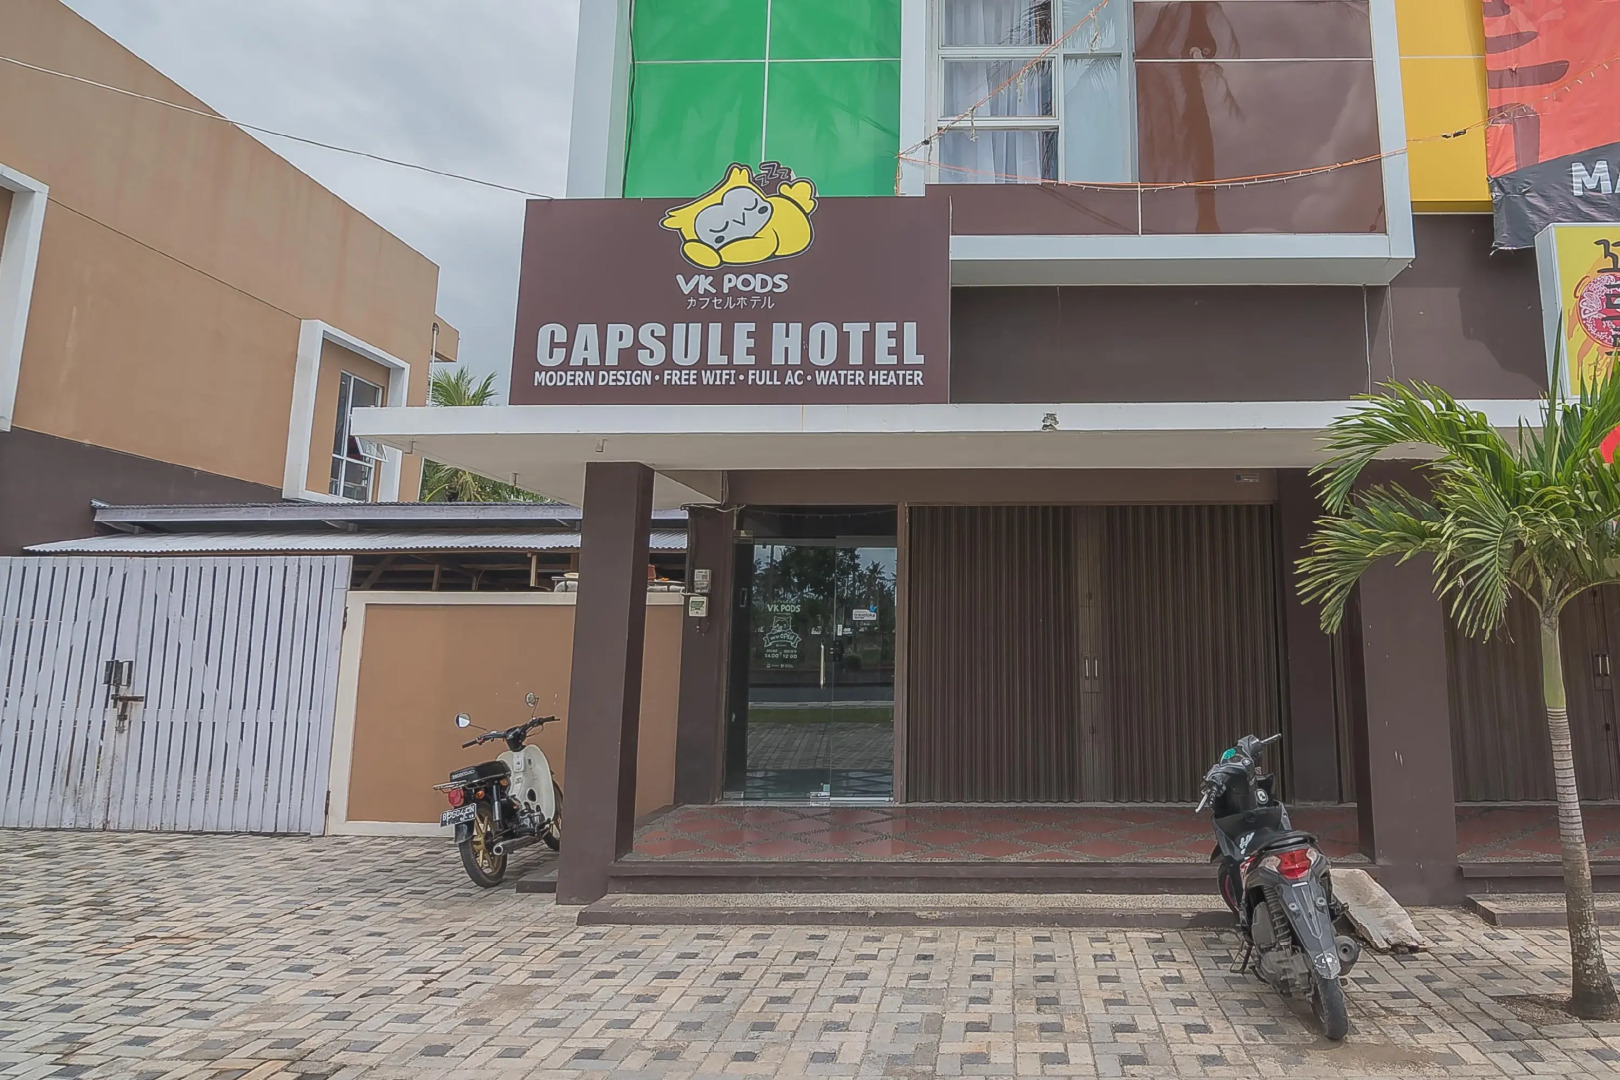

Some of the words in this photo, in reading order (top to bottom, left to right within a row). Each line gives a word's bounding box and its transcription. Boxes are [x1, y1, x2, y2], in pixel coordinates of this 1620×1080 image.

[1571, 160, 1620, 197] M
[675, 274, 717, 295] VK
[723, 273, 789, 294] PODS
[536, 322, 756, 367] CAPSULE
[771, 321, 925, 367] HOTEL
[534, 370, 595, 386] MODERN
[598, 370, 652, 386] DESIGN
[663, 370, 698, 386] FREE
[701, 370, 736, 386] WIFI
[748, 370, 782, 386] FULL
[784, 370, 804, 386] AC
[815, 370, 865, 386] WATER
[869, 370, 924, 386] HEATER
[767, 603, 780, 612] VK
[780, 604, 801, 613] PODS
